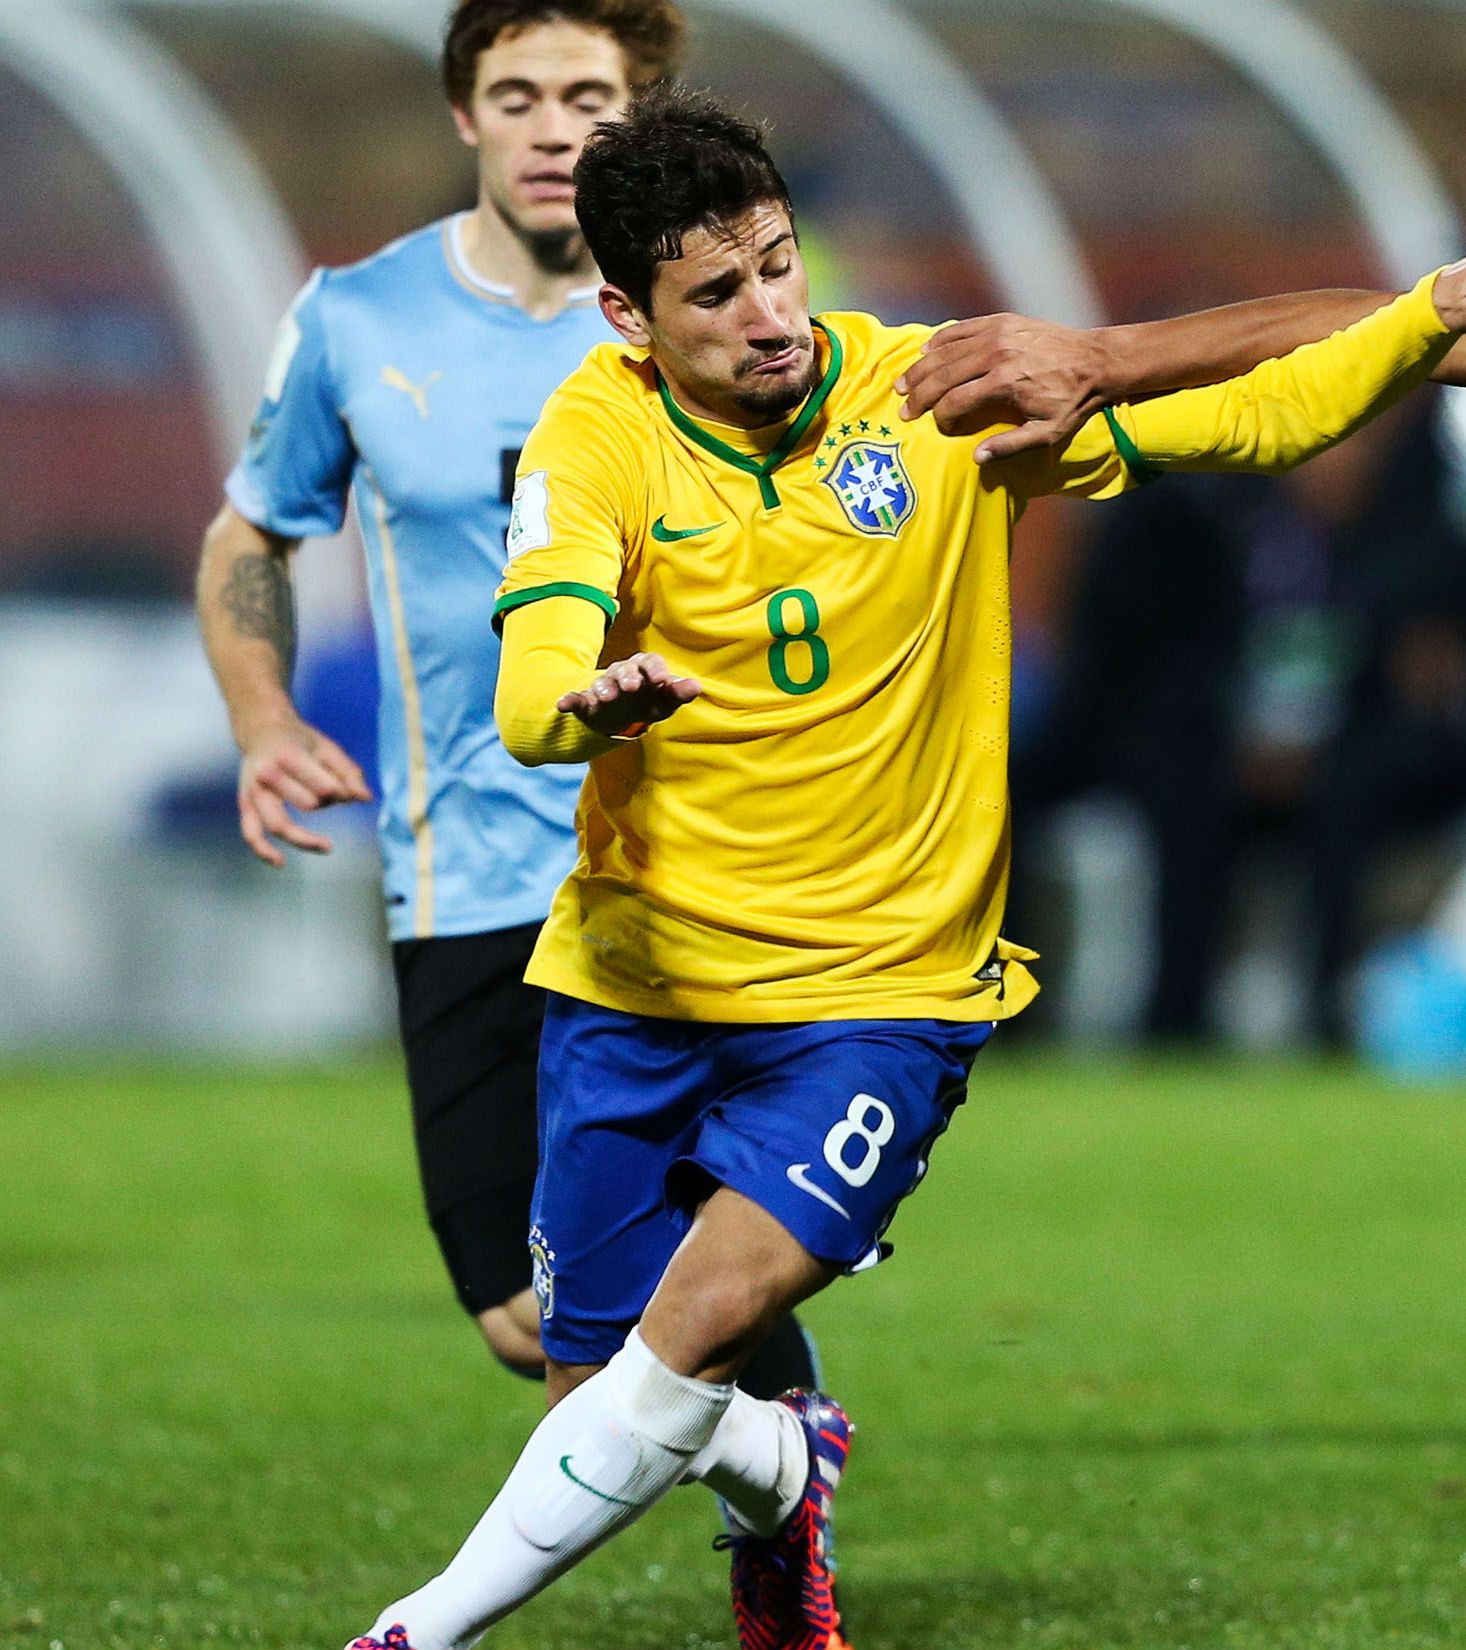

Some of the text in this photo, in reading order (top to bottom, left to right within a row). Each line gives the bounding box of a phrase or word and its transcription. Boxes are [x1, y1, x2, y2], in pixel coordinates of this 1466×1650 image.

[860, 476, 884, 495] CBF
[767, 588, 830, 695] 8
[823, 1092, 895, 1188] 8
